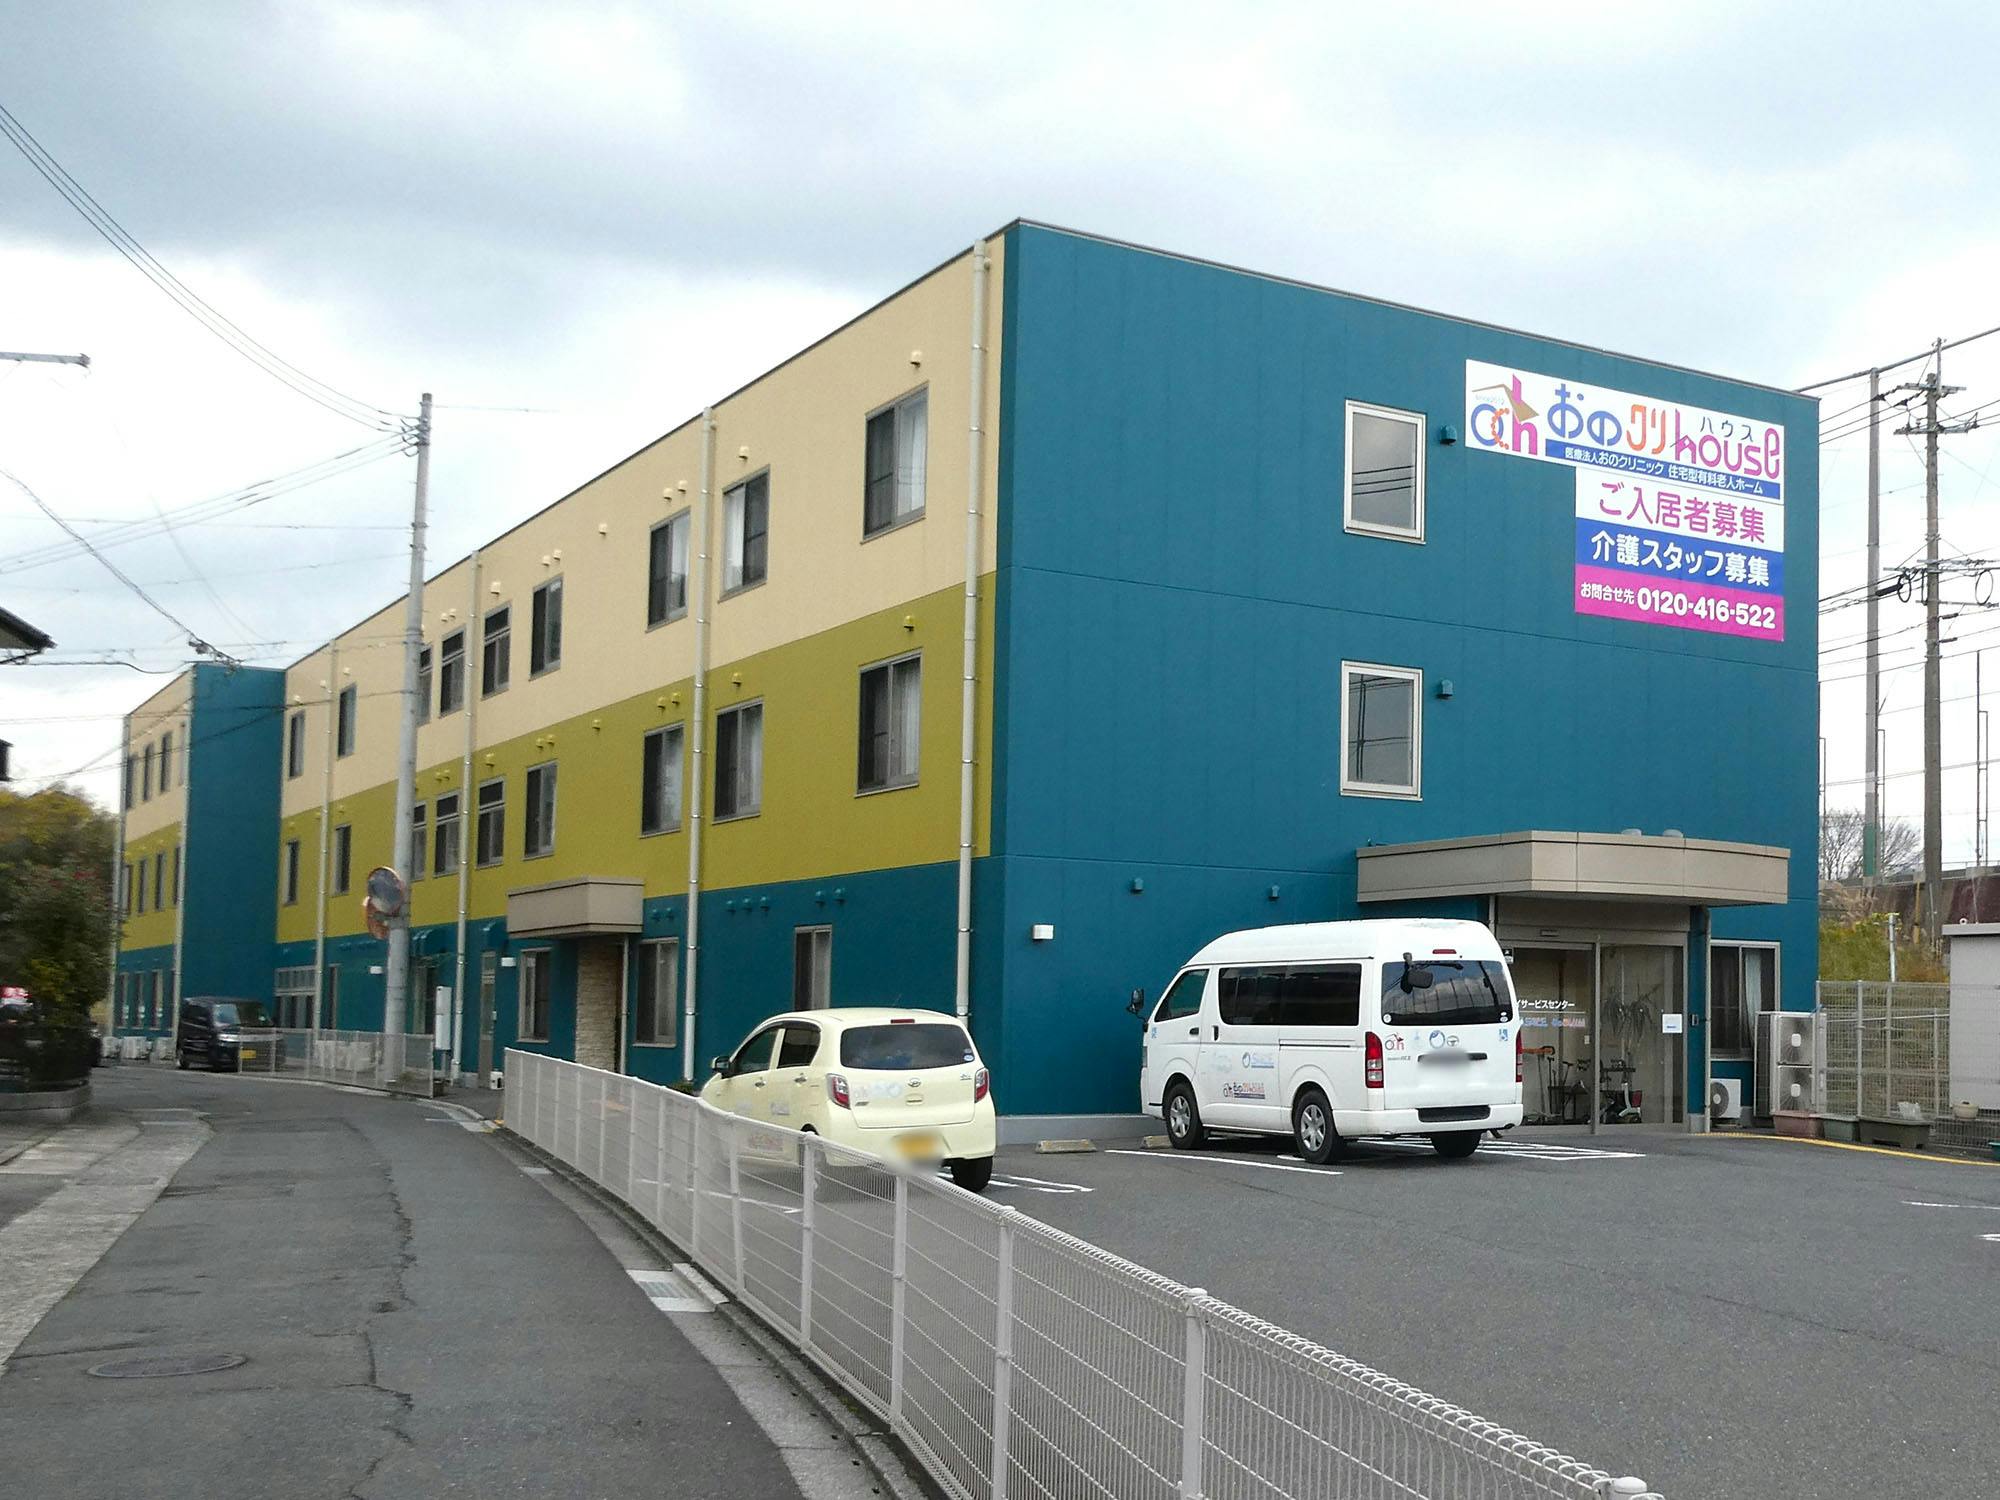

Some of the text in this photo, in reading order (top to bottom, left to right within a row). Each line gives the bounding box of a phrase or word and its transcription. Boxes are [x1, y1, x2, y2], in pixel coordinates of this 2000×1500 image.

[1700, 416, 1753, 441] ハウス
[1564, 447, 1763, 494] 医療法人おのクリニック 住宅型有料老人ホーム
[1599, 482, 1765, 544] ご入居者募集
[1591, 531, 1770, 587] 介護スタッフ募集
[1581, 582, 1776, 629] お問合せ先 0120-416-522
